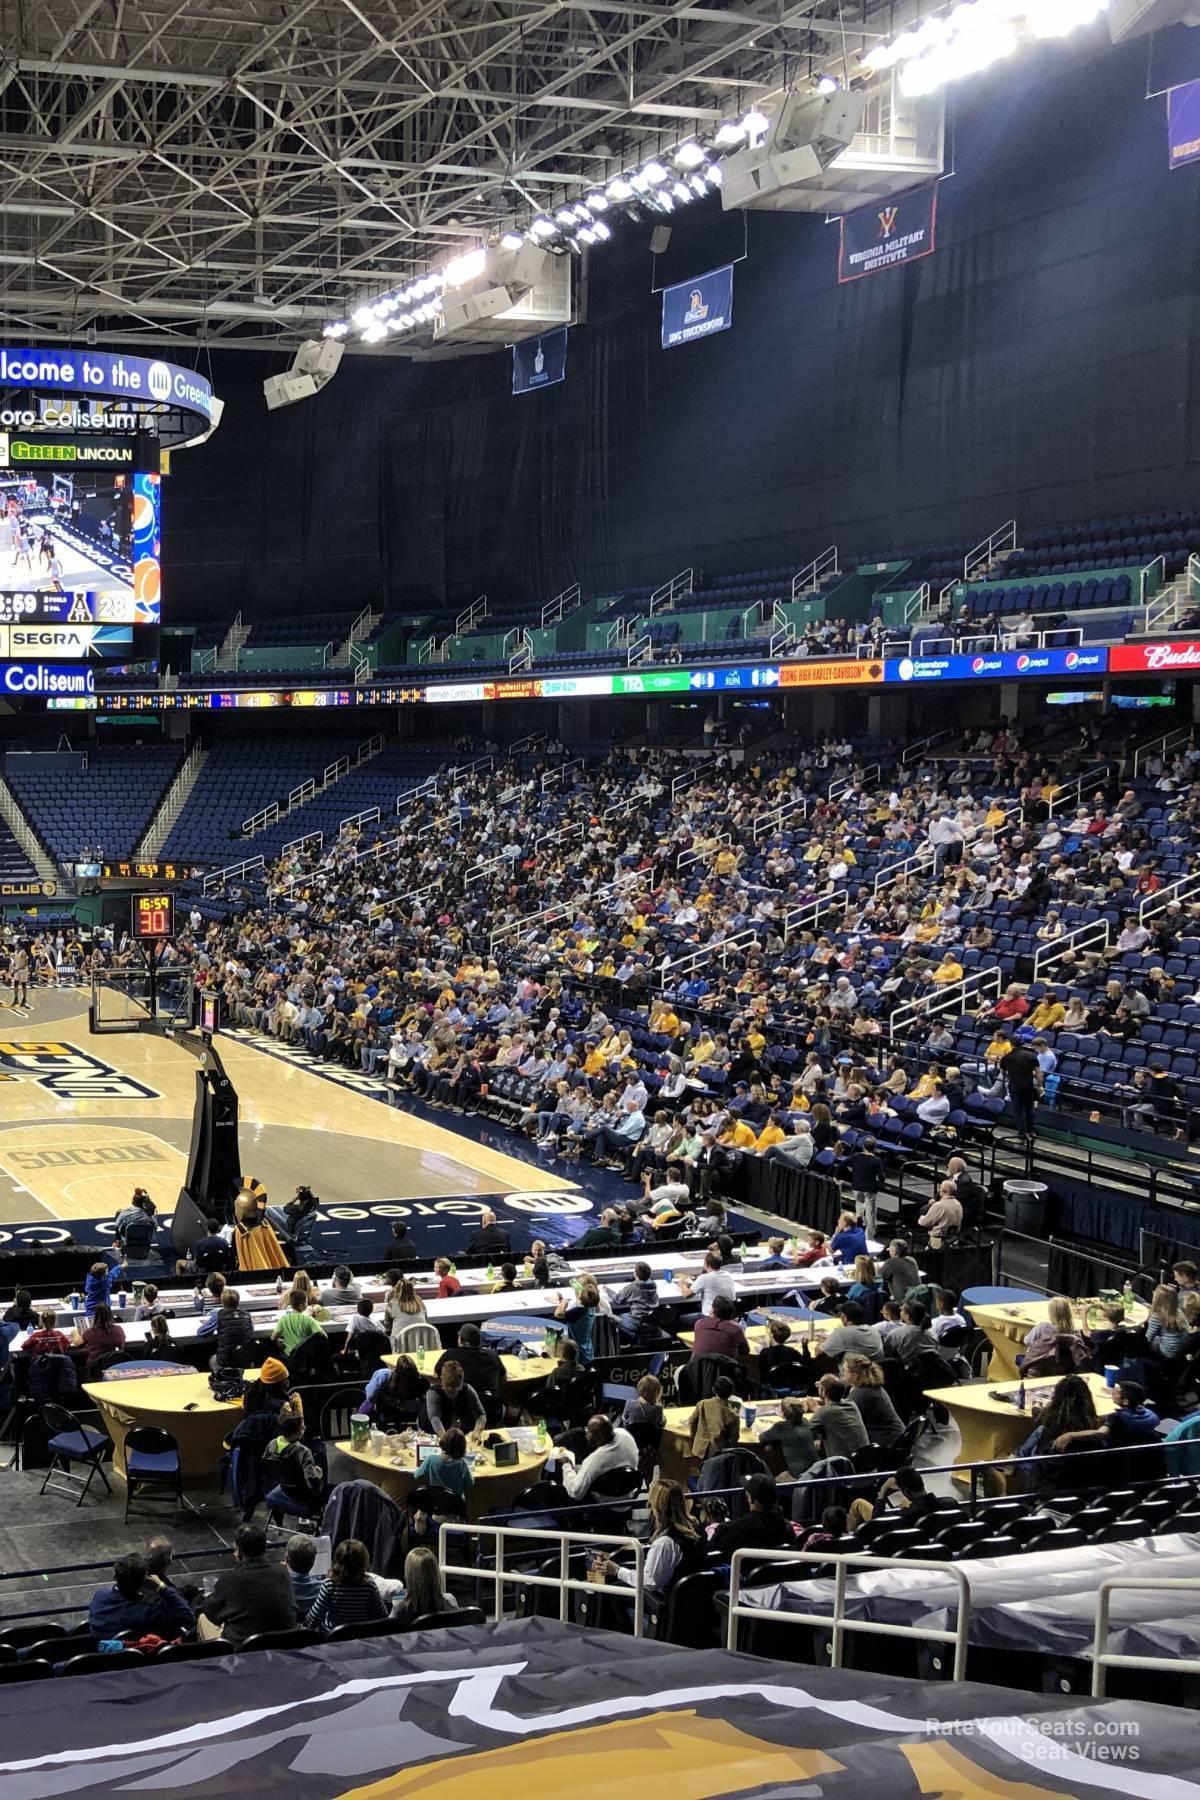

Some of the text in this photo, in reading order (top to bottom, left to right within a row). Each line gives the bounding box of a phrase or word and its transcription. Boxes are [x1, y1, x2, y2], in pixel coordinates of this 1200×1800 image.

[849, 229, 925, 264] VIRGINIA MILITARY
[864, 248, 907, 271] INSTITUTE
[83, 361, 104, 385] to
[111, 360, 141, 389] the
[42, 407, 137, 429] Coliseum
[11, 442, 132, 461] GREEN LINCOLN
[99, 596, 127, 618] 28
[13, 633, 81, 645] SEGRA
[984, 661, 1002, 671] pepsi
[1030, 658, 1049, 667] pepsi
[1078, 655, 1098, 665] pepsi
[5, 665, 85, 692] Coliseum
[798, 668, 811, 681] HIGH
[314, 694, 327, 706] 28
[139, 864, 158, 873] 16:59
[2, 884, 40, 895] CLUB
[140, 897, 169, 910] 16:59
[140, 912, 165, 933] 30
[6, 1144, 171, 1169] SOCON
